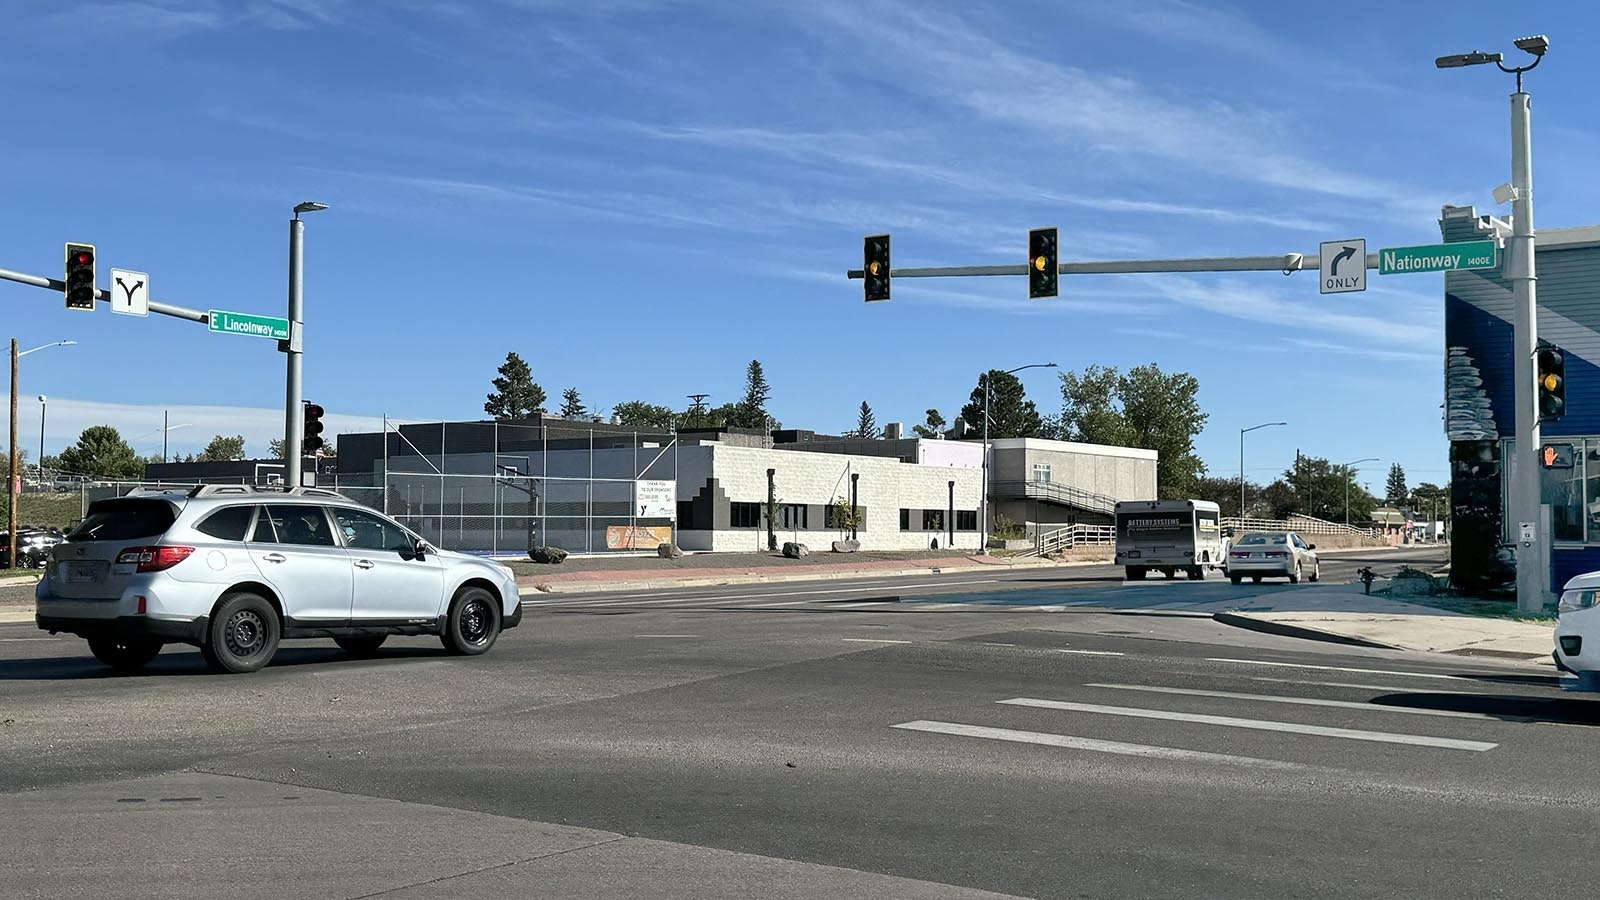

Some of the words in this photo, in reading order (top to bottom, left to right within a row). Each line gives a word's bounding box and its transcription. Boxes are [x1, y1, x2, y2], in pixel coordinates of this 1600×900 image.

[1384, 252, 1461, 272] Nationway
[1467, 256, 1490, 265] 1400E
[1327, 277, 1359, 289] ONLY
[211, 313, 219, 329] E
[224, 314, 274, 337] Lincolnway
